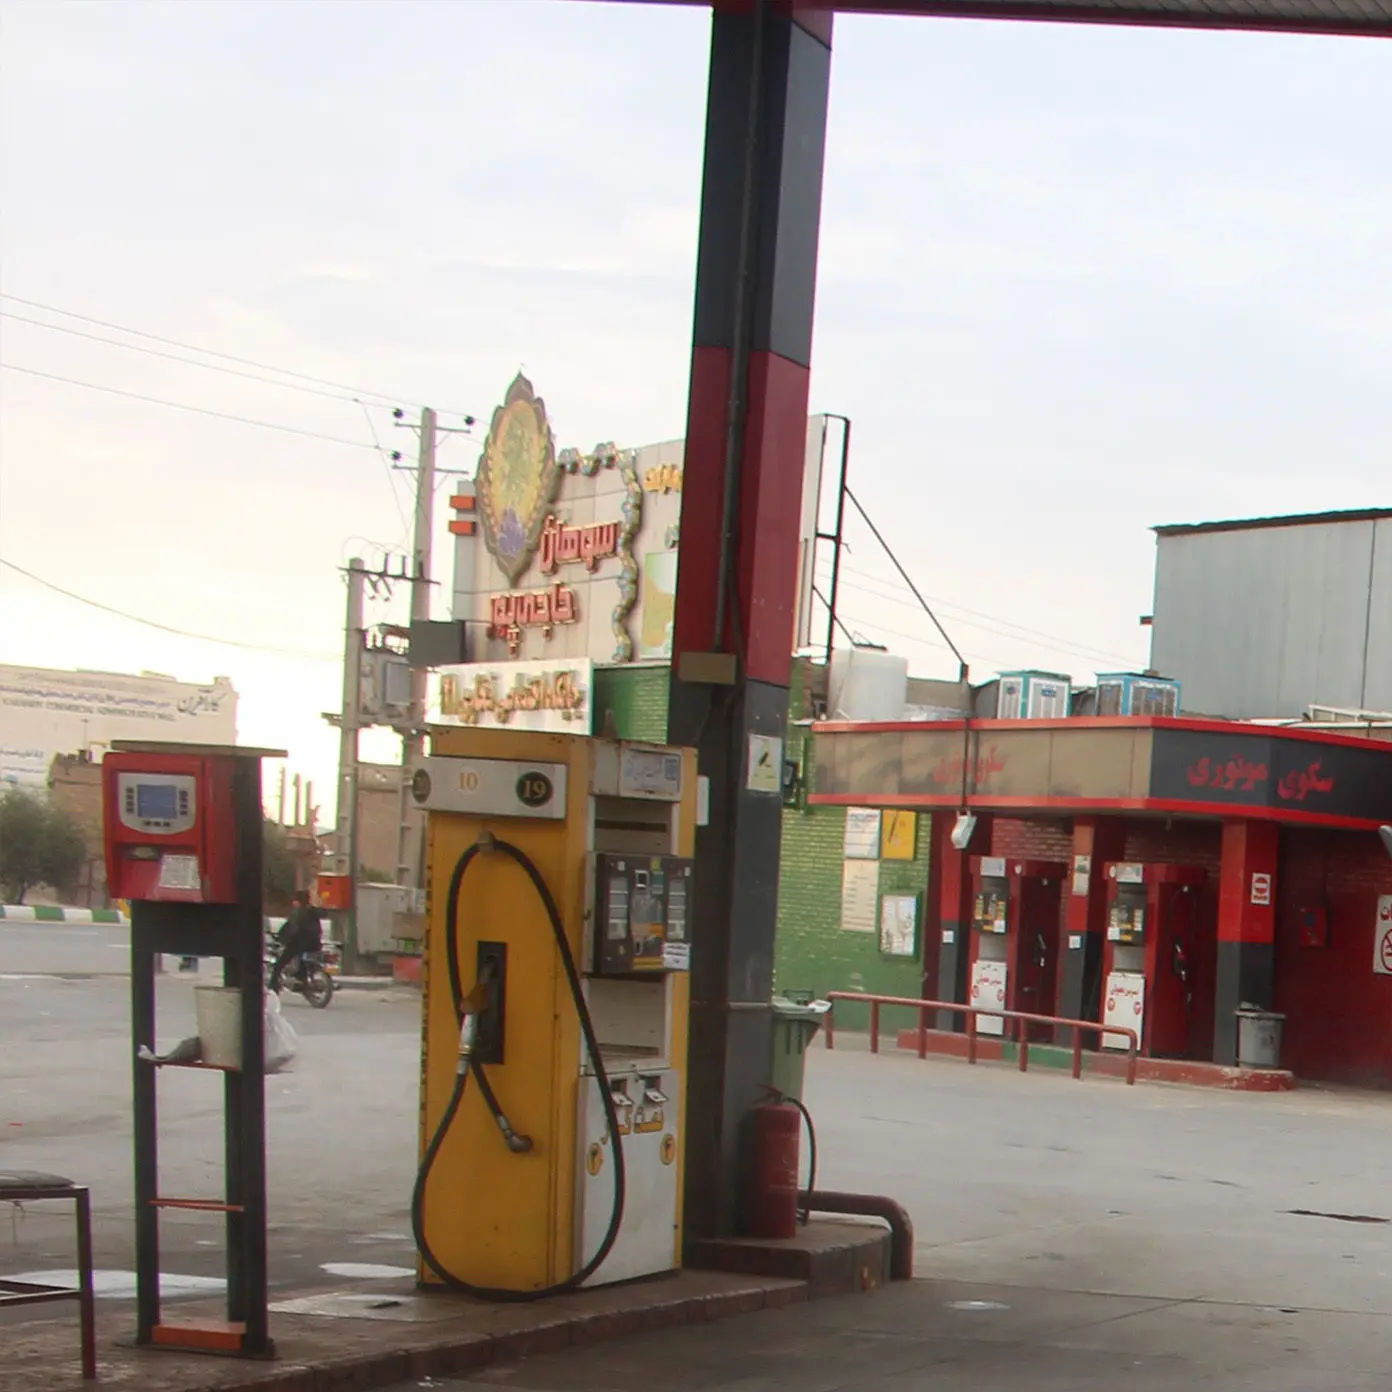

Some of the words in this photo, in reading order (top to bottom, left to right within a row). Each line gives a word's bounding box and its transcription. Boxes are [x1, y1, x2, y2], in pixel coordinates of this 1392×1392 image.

[522, 779, 548, 800] 19
[1188, 752, 1268, 790] موتوری
[1277, 757, 1334, 800] سکوی
